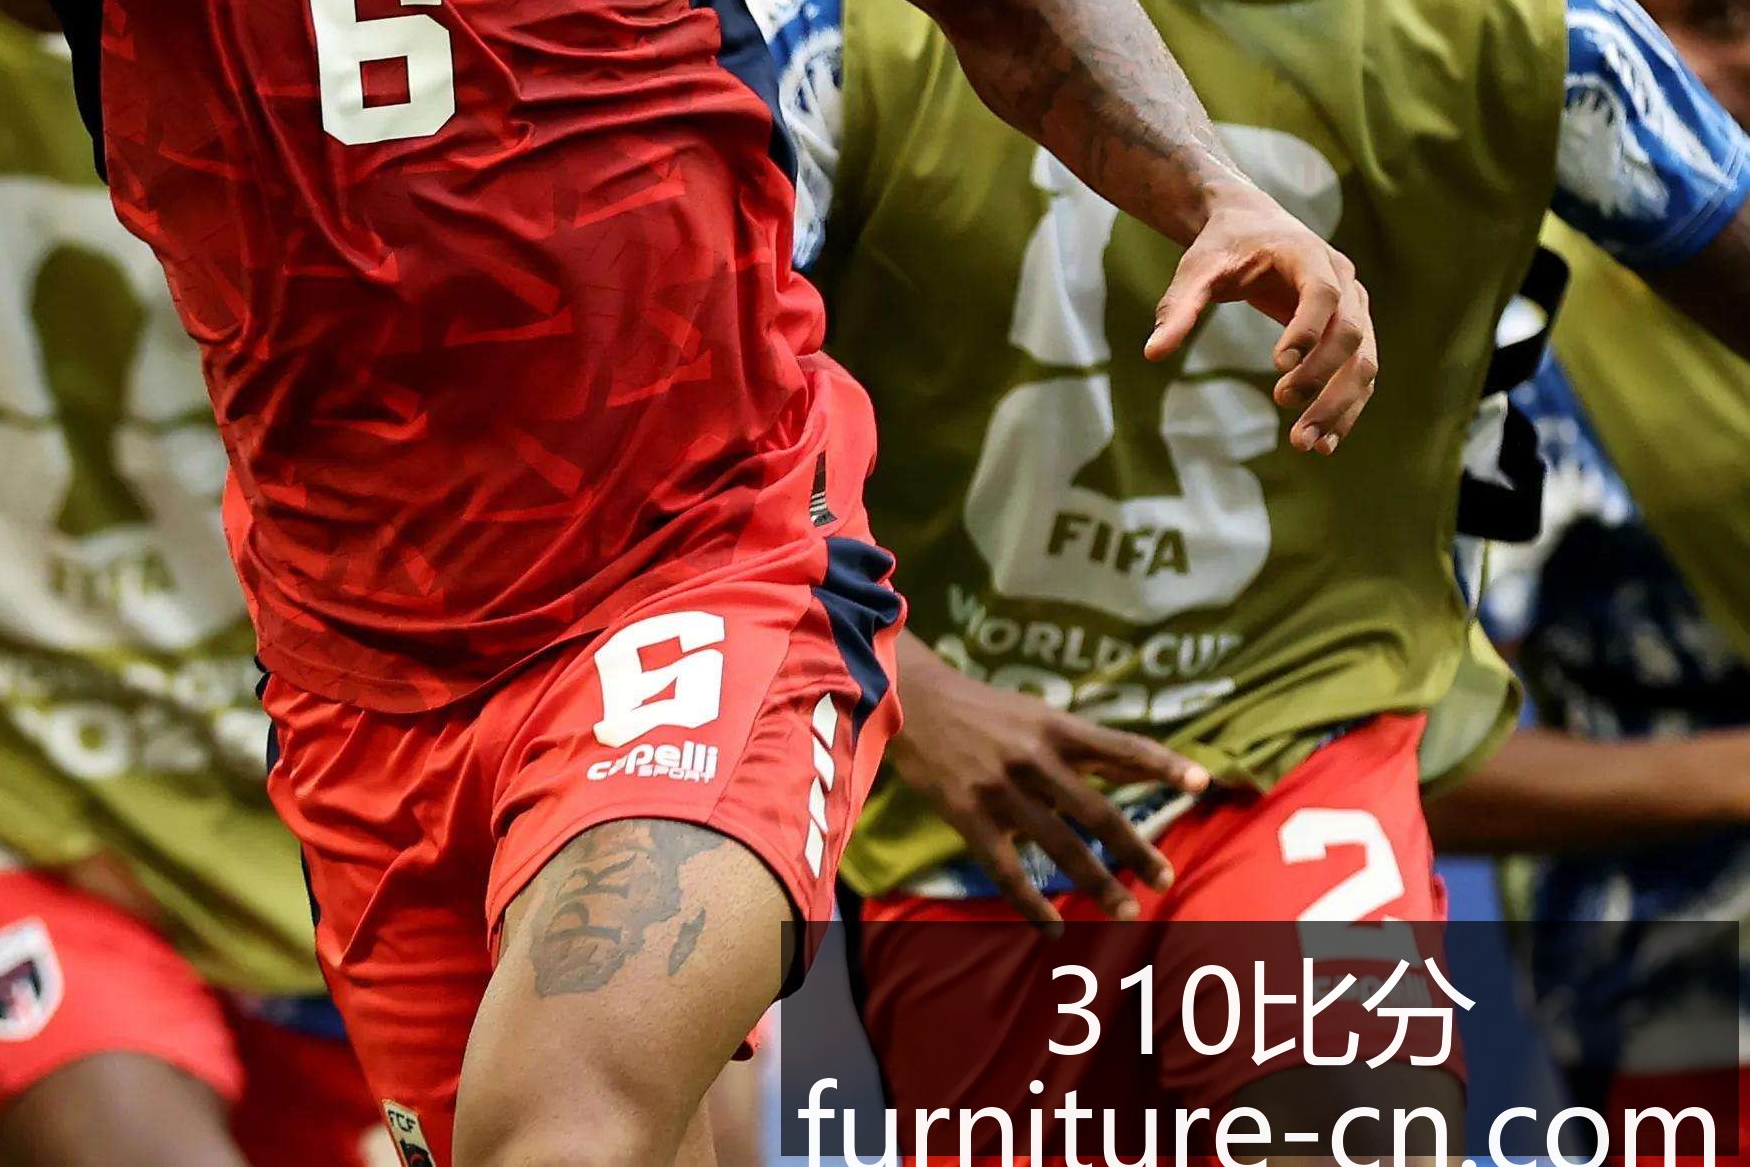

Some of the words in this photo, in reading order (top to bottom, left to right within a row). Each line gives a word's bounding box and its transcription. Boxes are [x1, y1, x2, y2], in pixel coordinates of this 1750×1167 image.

[1047, 511, 1191, 577] FIFA
[592, 610, 725, 748] 6
[946, 584, 1136, 672] WORLD
[1277, 808, 1424, 969] 2
